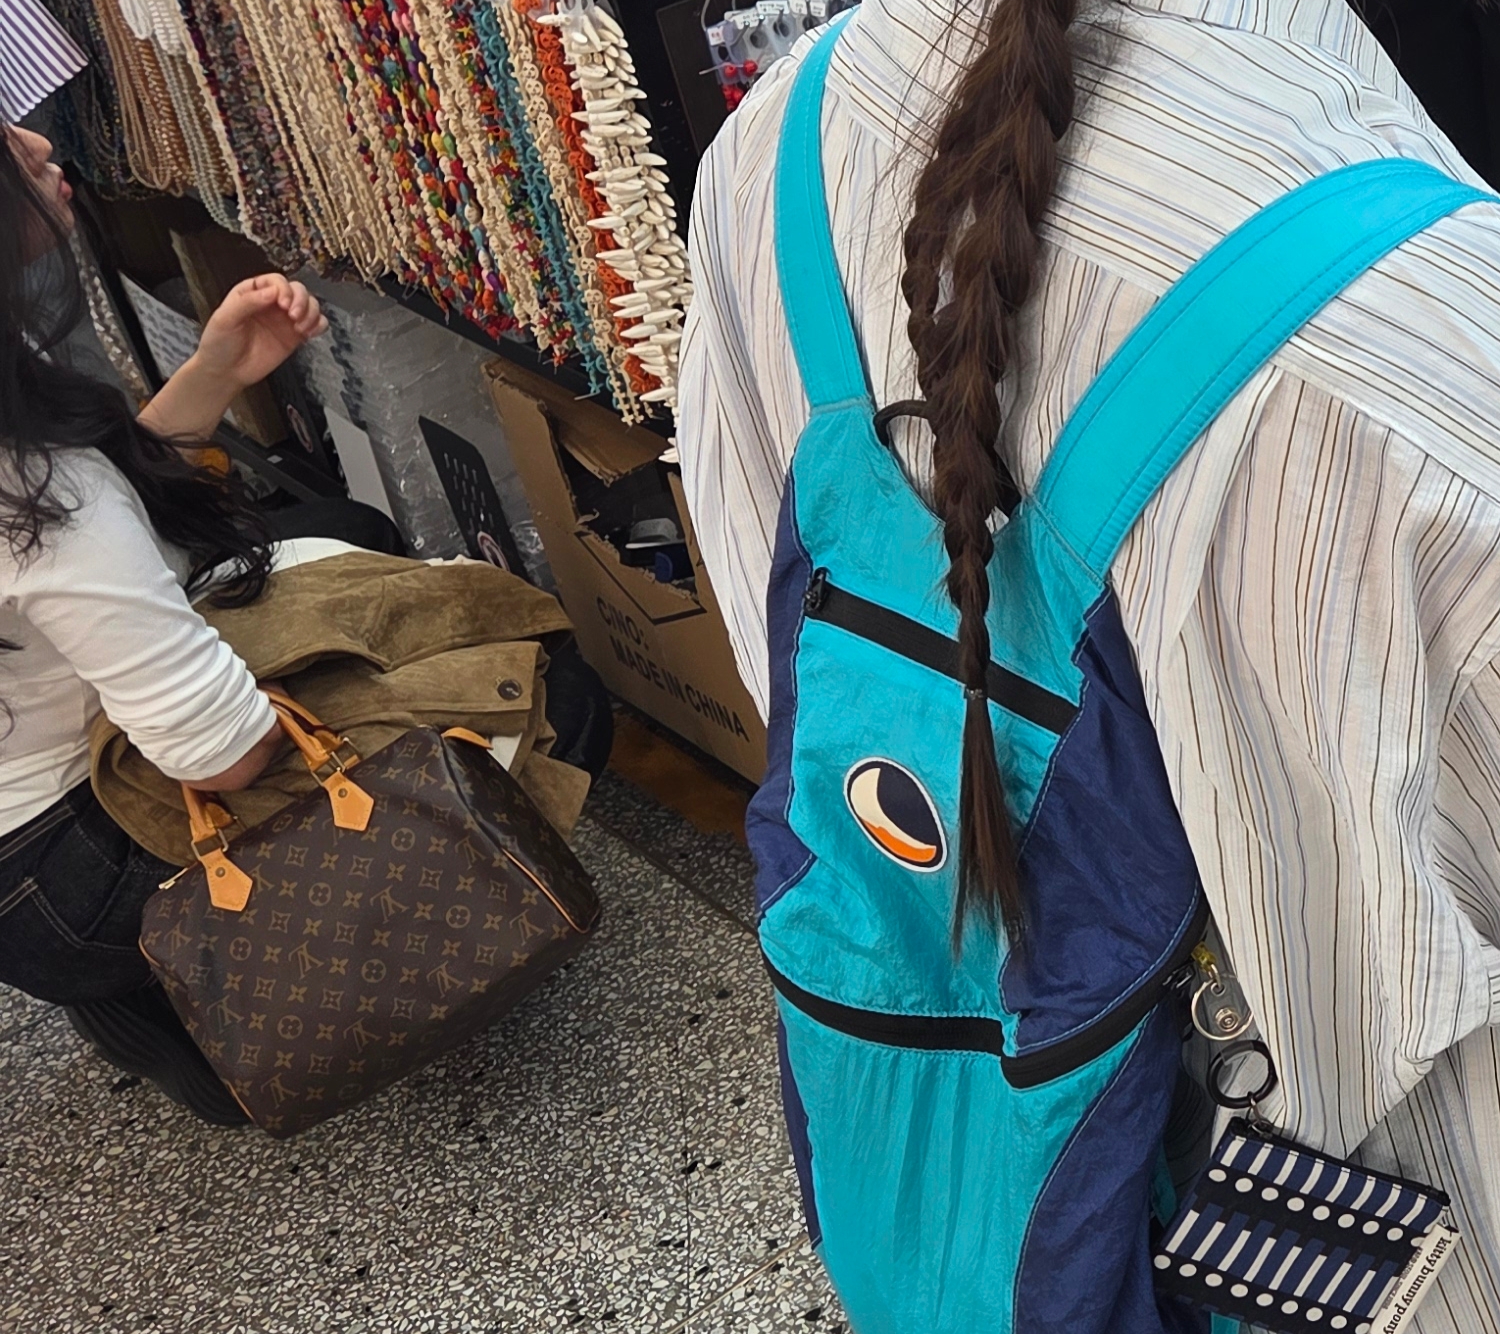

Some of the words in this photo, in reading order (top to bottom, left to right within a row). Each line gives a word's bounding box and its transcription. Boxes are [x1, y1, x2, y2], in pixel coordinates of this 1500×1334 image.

[609, 634, 666, 690] MADE
[662, 668, 687, 704] IN
[684, 683, 750, 743] CHINA
[1425, 1236, 1452, 1267] kitty
[1401, 1264, 1435, 1306] bunny
